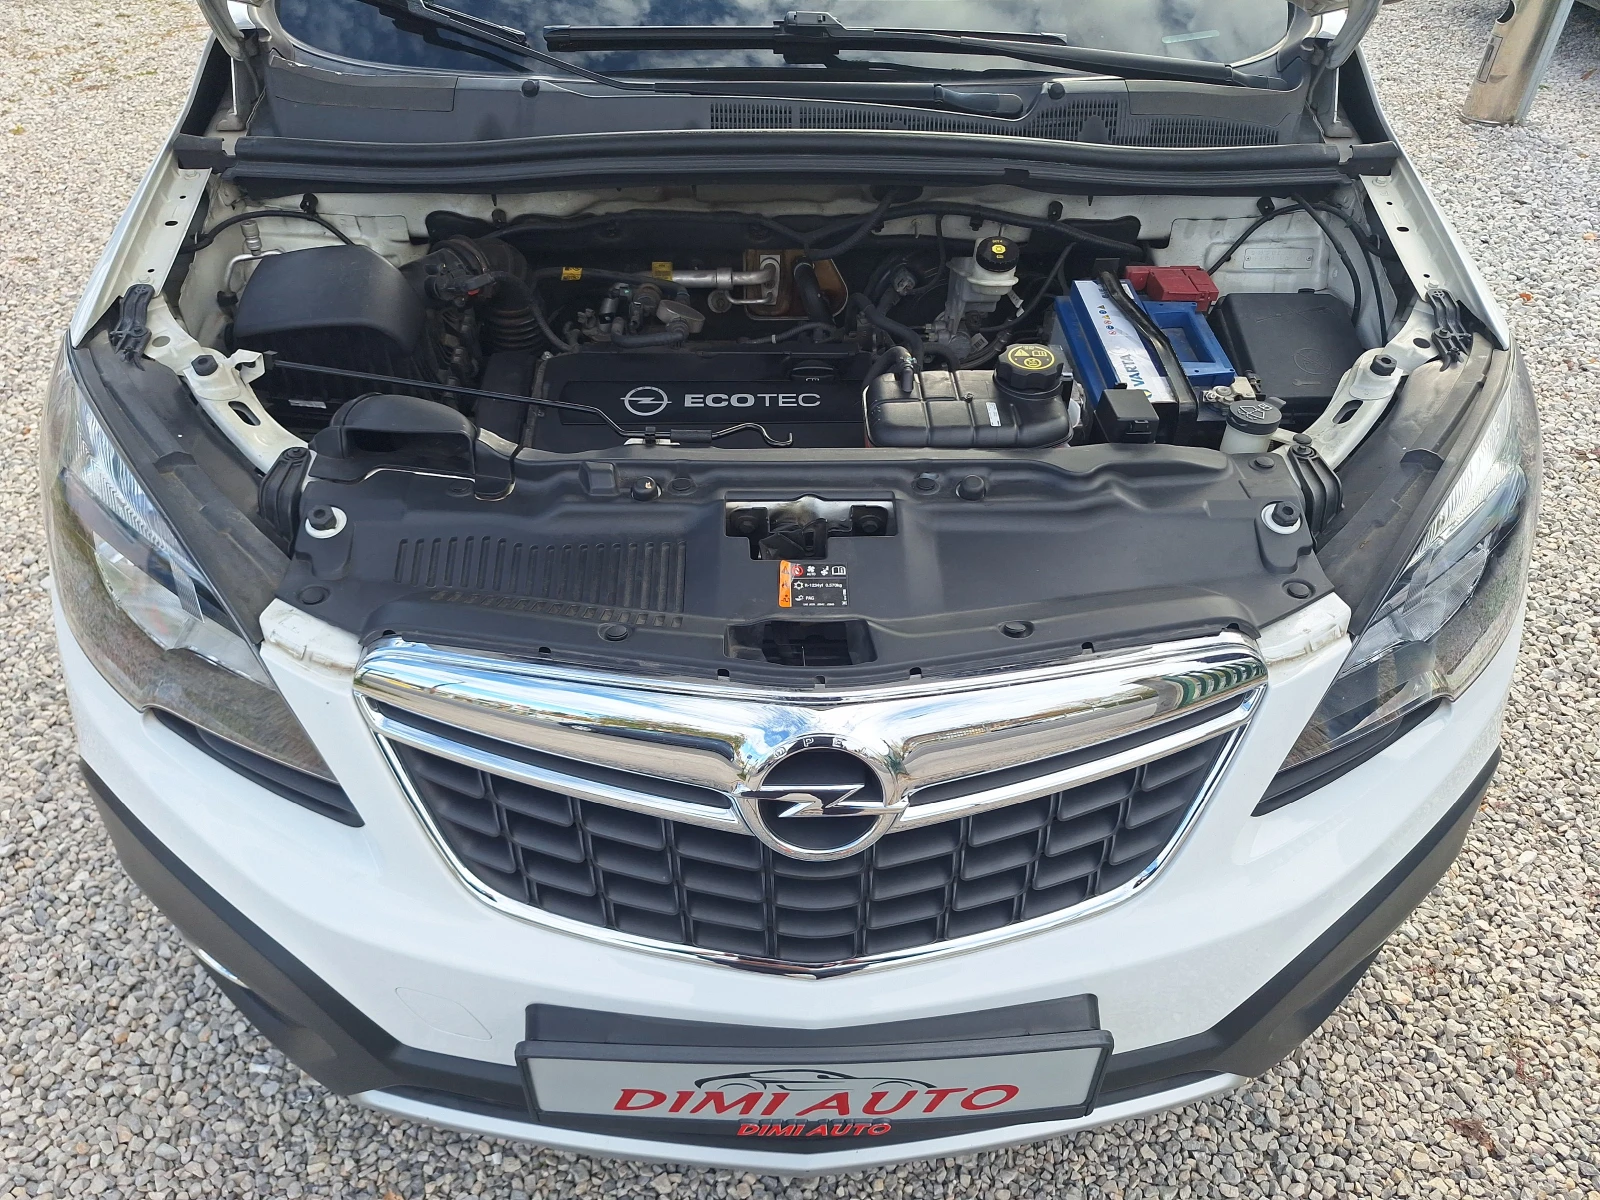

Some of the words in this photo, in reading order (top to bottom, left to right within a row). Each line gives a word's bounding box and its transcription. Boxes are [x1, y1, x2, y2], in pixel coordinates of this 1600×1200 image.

[1119, 353, 1145, 387] VARTA
[684, 393, 821, 407] ECOTEC
[613, 1088, 790, 1116] DIMI
[796, 1084, 1019, 1117] AUTO
[736, 1123, 805, 1137] DIMI
[806, 1122, 892, 1137] AUTO
